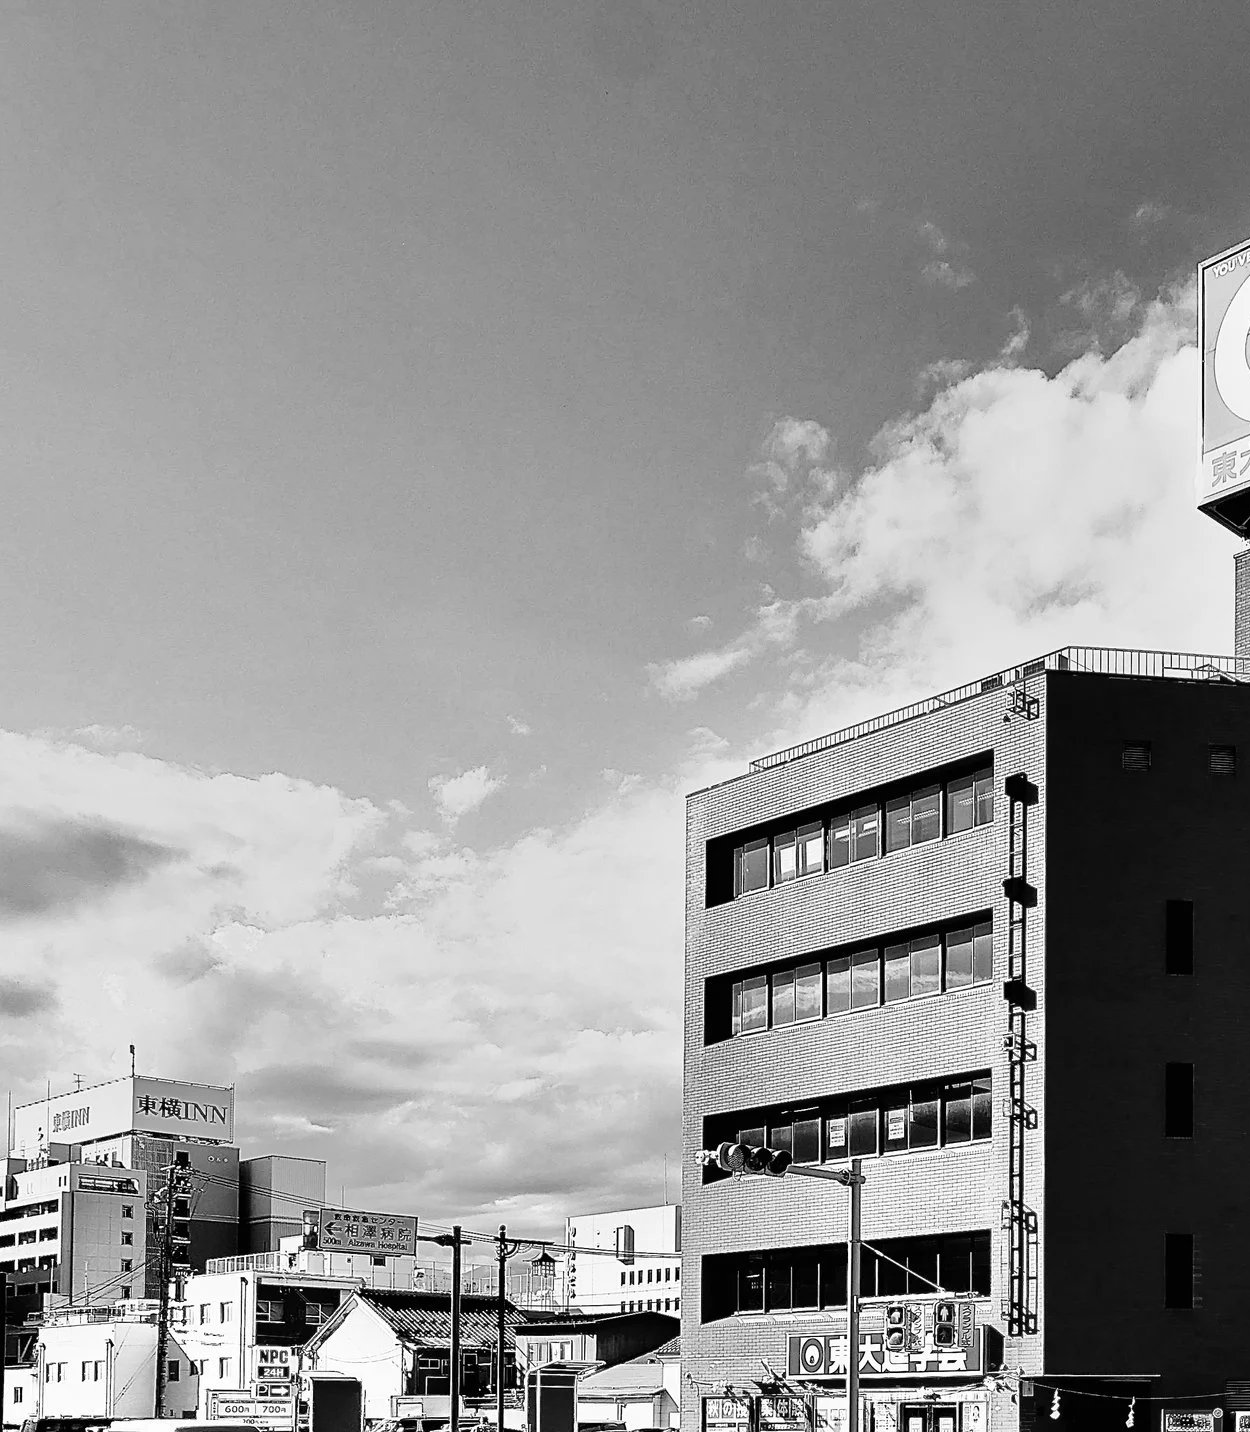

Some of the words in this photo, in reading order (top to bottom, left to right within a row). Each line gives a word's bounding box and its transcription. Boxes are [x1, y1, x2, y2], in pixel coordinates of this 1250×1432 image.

[135, 1094, 228, 1125] 東横INN
[344, 1223, 412, 1241] 相澤病院
[322, 1236, 342, 1246] 500m
[348, 1239, 376, 1248] Aizawa
[378, 1241, 408, 1251] Hospital
[259, 1349, 289, 1364] NPC
[263, 1368, 284, 1376] 24H
